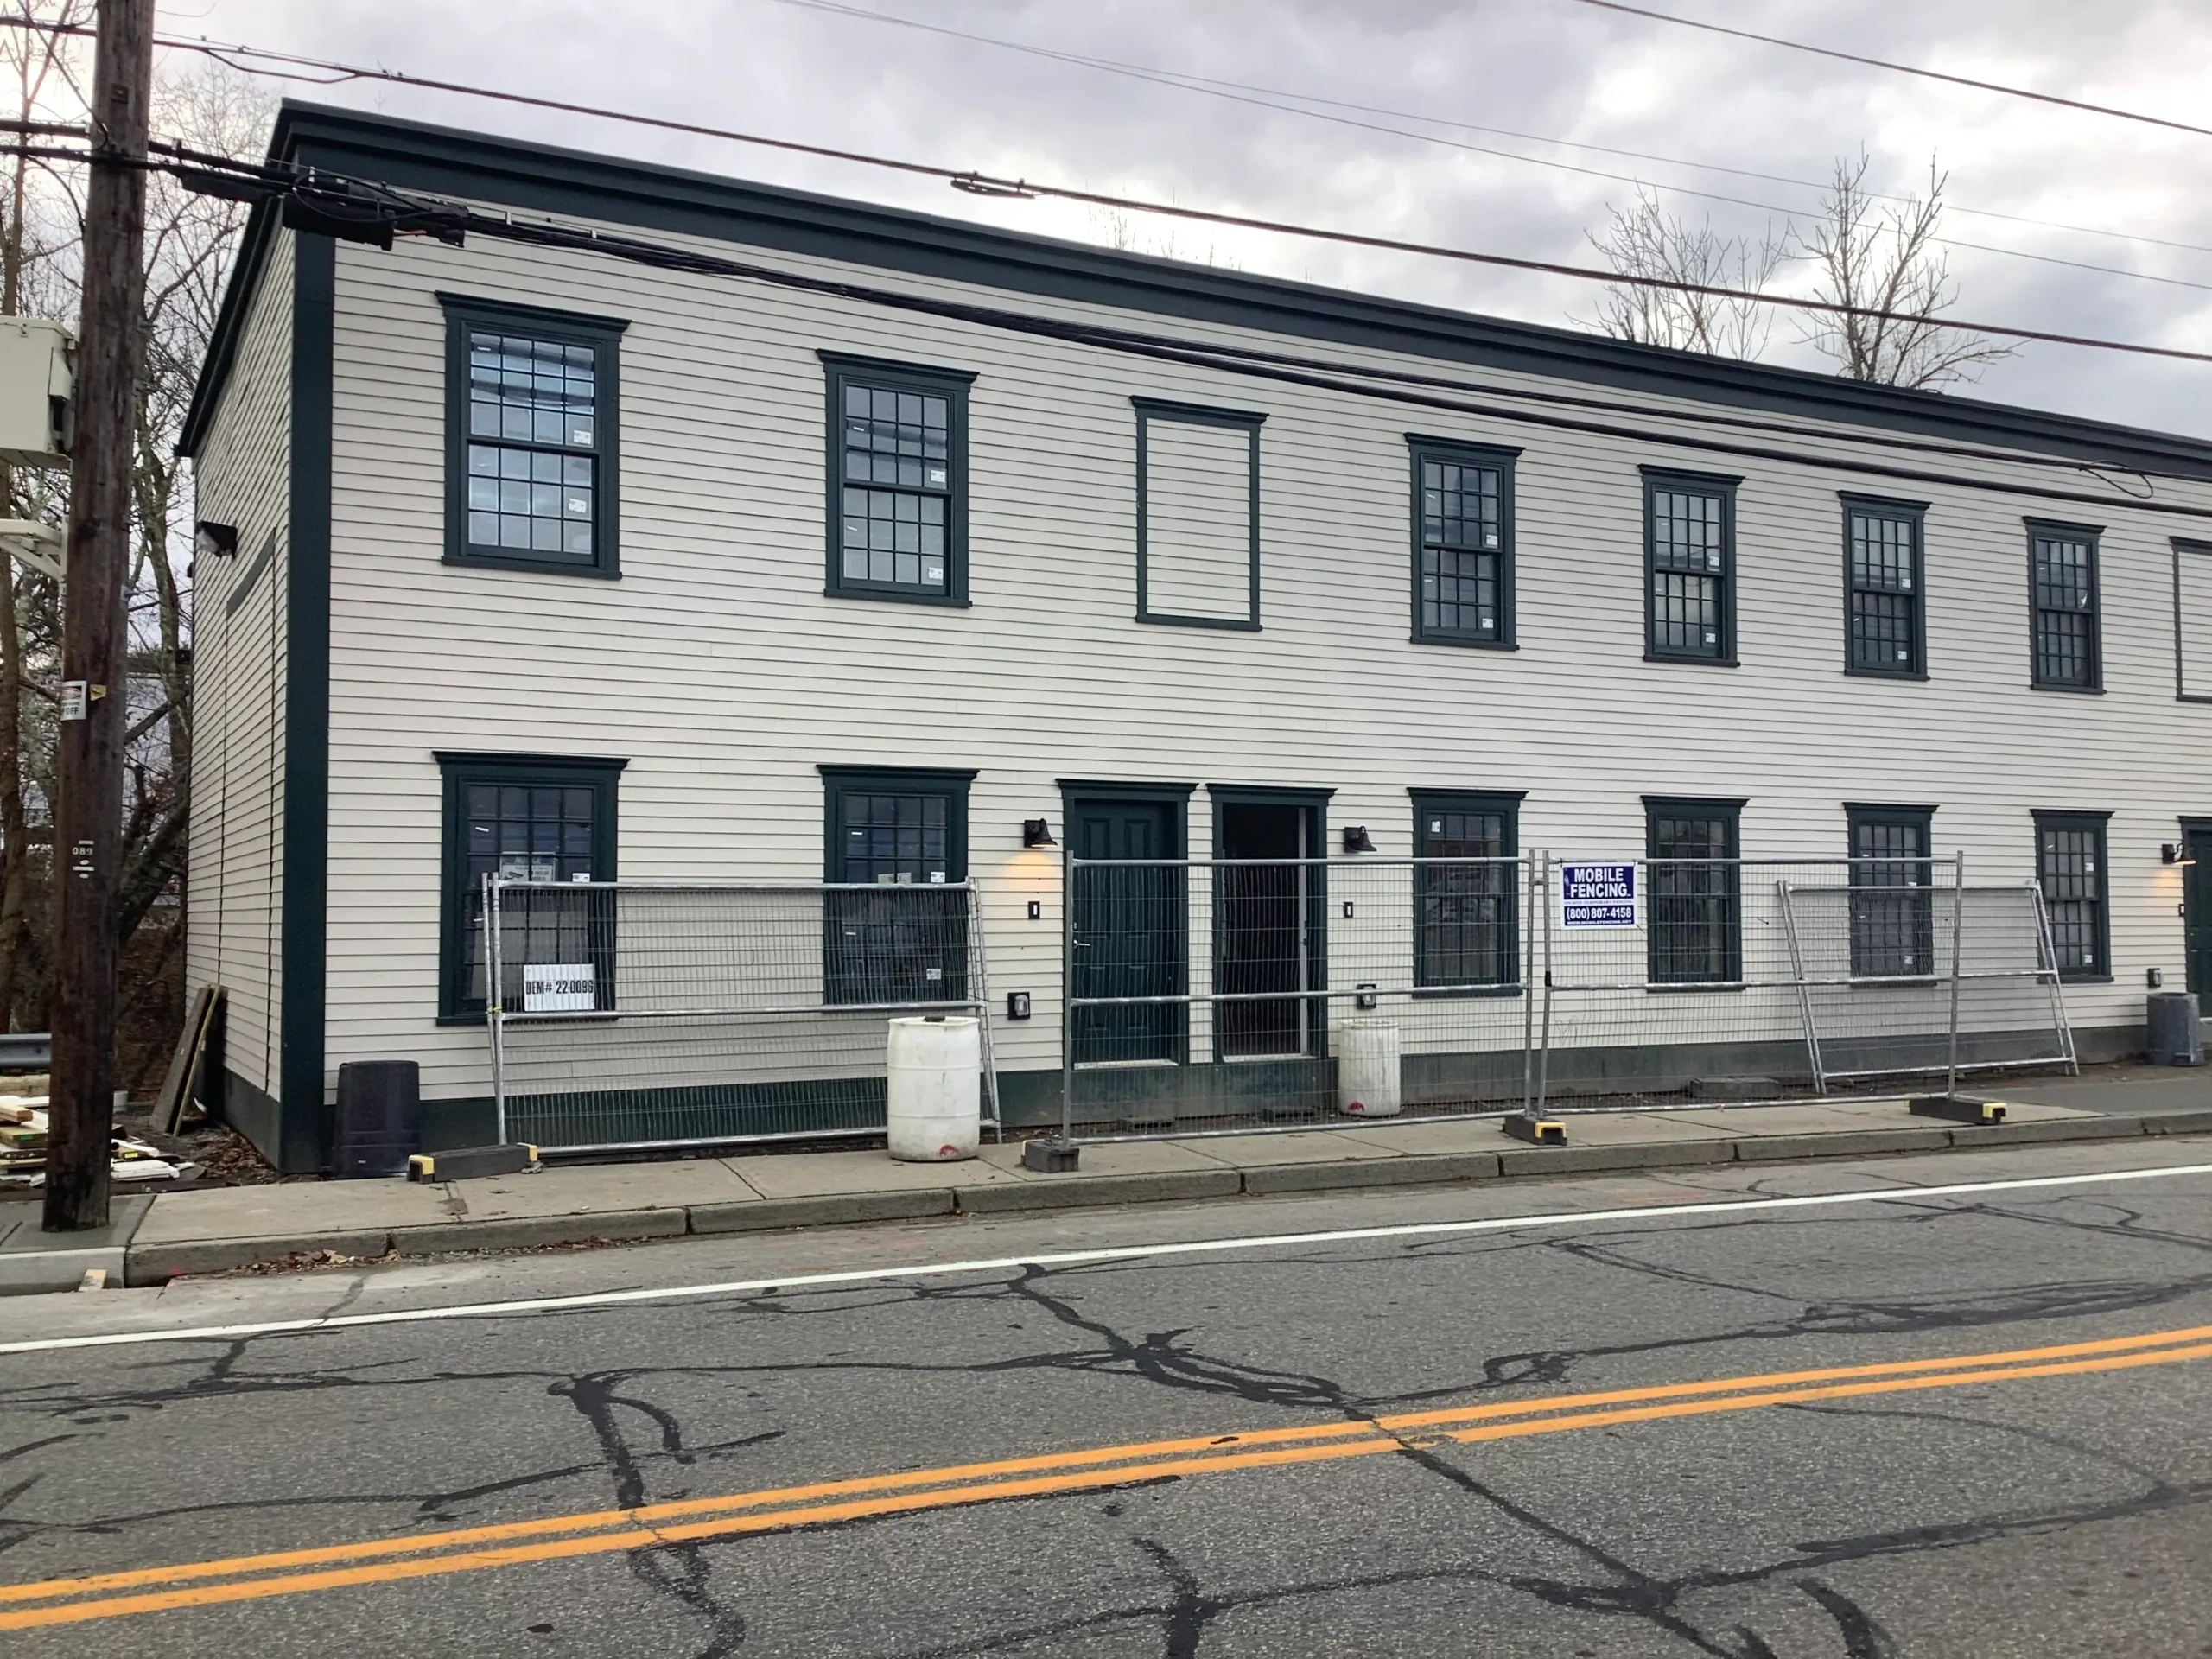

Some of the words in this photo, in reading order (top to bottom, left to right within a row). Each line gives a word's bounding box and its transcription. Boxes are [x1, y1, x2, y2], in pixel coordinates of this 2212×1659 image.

[1574, 868, 1624, 882] MOBILE
[1570, 883, 1628, 898] FENCING
[1567, 907, 1590, 920] (800)
[1591, 906, 1631, 918] 807-4158
[525, 981, 552, 995] DEM#
[556, 980, 594, 994] 22-0096
